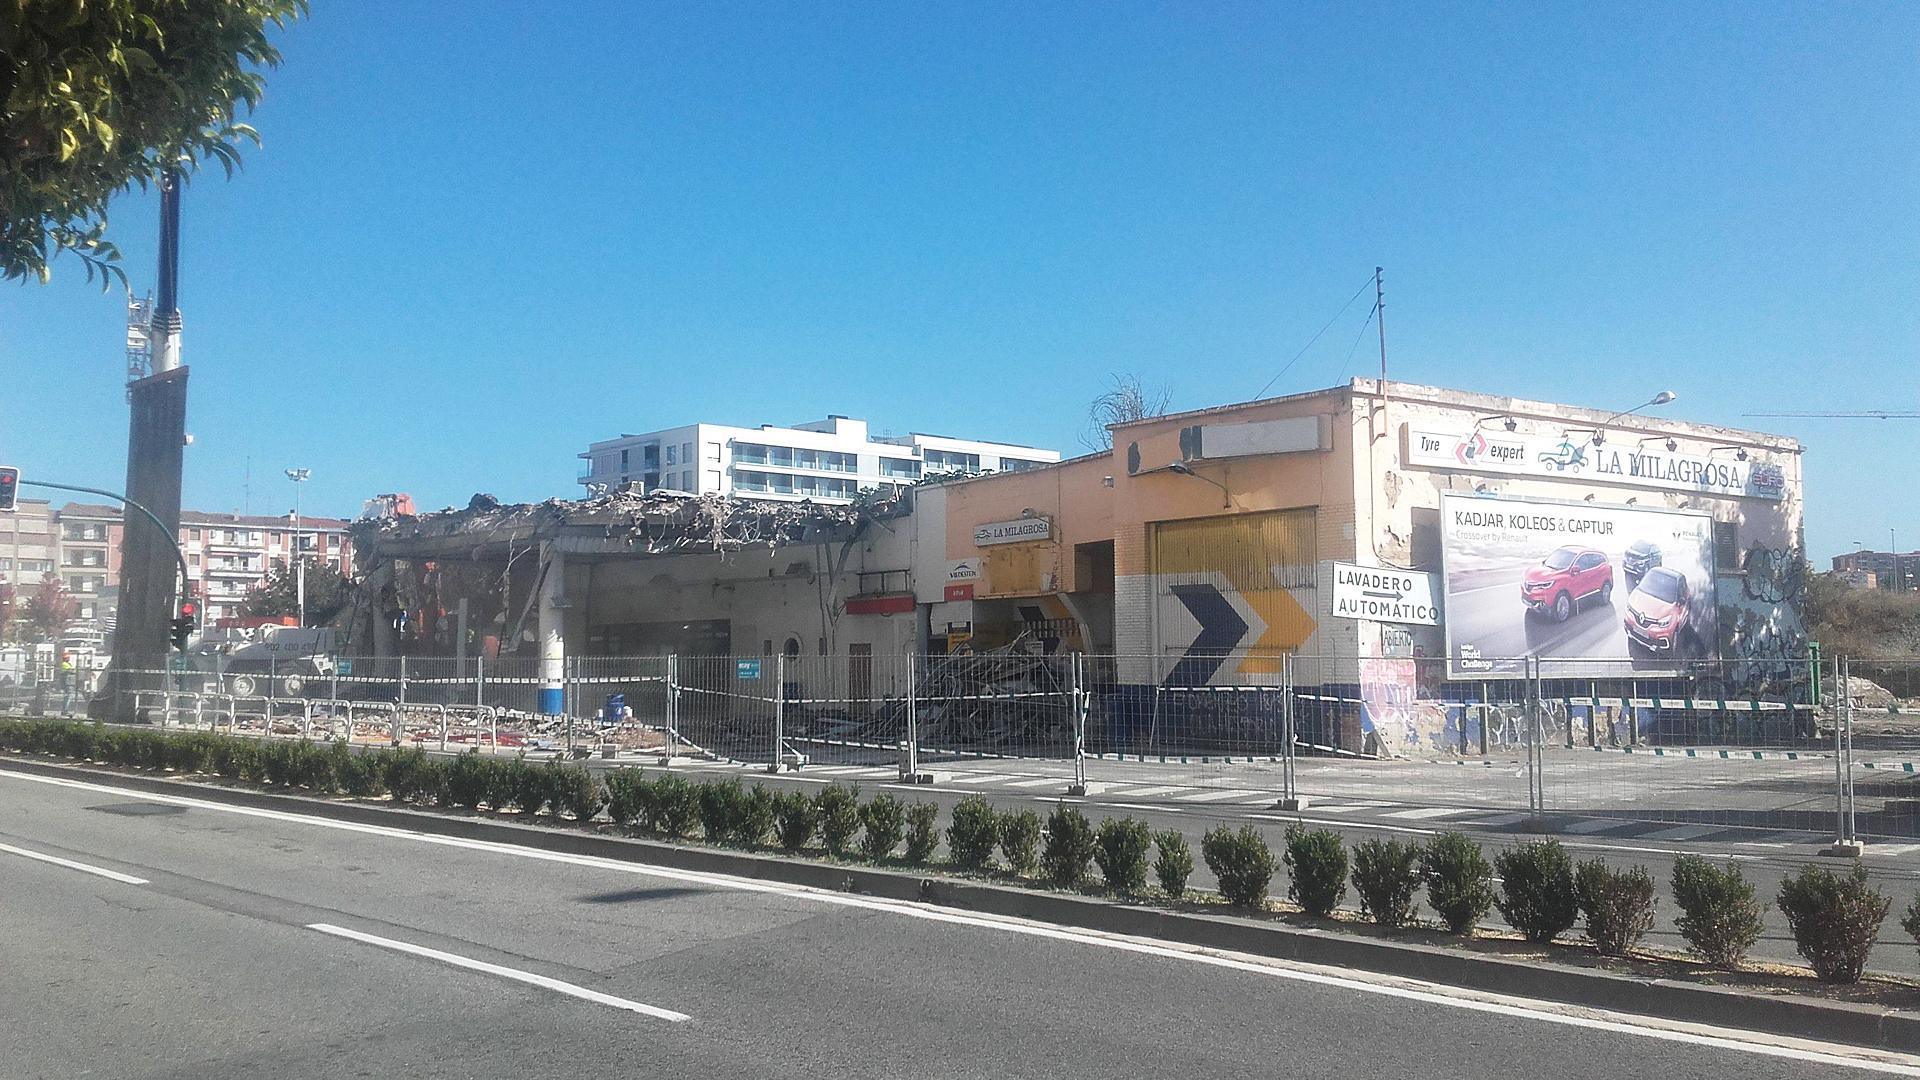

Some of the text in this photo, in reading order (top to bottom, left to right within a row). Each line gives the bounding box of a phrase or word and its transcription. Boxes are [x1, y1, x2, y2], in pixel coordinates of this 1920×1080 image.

[1421, 437, 1525, 462] Tyre expert
[1595, 449, 1743, 489] LA MILAGROSA
[993, 523, 1048, 538] LA MILAGROSA
[1455, 511, 1614, 535] KADJAR, KOLEOS & CAPTUR
[1456, 529, 1528, 544] Crossover by Renault
[1339, 570, 1412, 591] LAVADERO
[1338, 598, 1438, 620] AUTOMATICO
[1383, 630, 1412, 646] ABIERTO
[1461, 650, 1481, 659] World
[1461, 660, 1493, 670] Challenge
